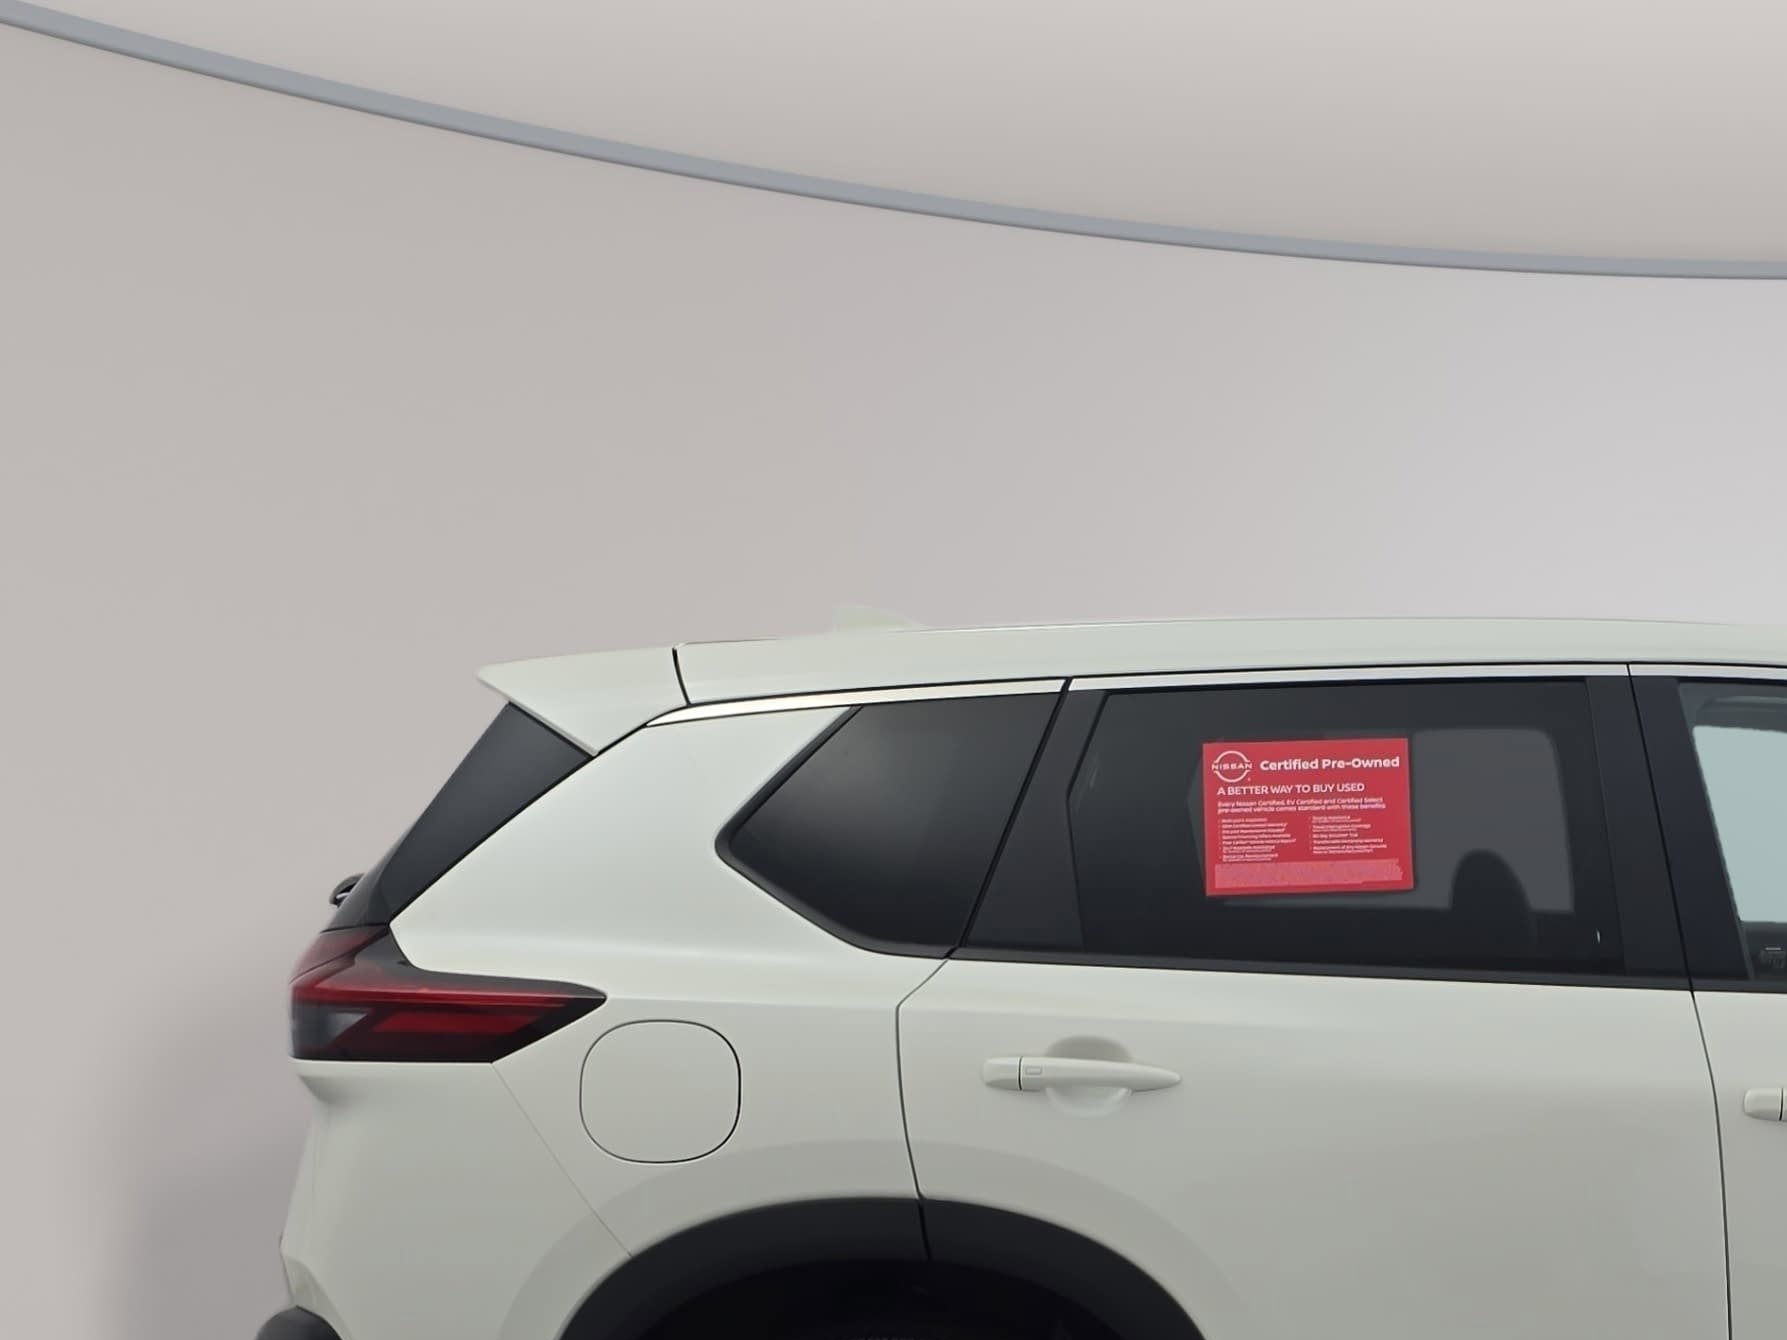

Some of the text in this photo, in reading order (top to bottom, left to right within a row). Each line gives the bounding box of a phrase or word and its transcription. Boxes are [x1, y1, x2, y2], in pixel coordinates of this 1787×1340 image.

[1260, 756, 1400, 771] Certified Pre-Owned
[1217, 783, 1365, 796] A BETTER WAY TO BUY USED
